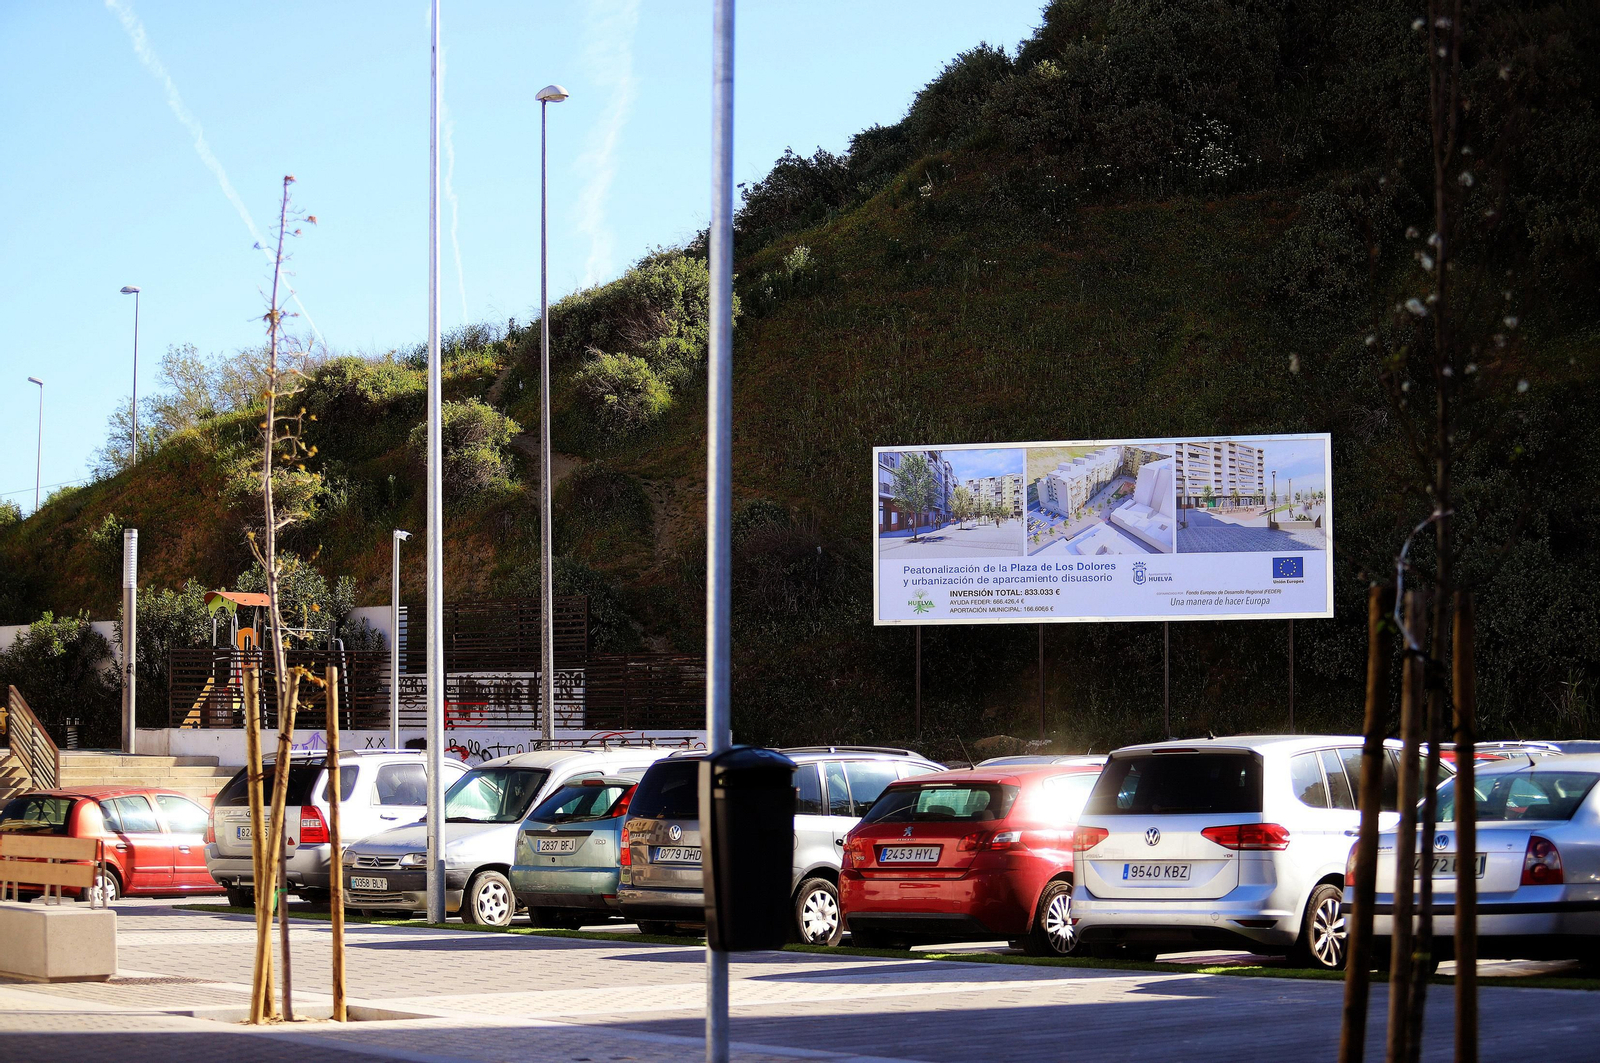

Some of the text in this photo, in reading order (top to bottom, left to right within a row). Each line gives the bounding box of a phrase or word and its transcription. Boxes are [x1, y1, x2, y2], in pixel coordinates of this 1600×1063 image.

[903, 561, 1116, 574] Peatonalización de la Plaza de Los Dolores
[903, 572, 1113, 587] y urbanización de aparcamiento disuasorio
[950, 588, 993, 597] INVERSIÓN
[1024, 588, 1053, 596] 833.033
[1055, 588, 1060, 596] €
[1170, 596, 1270, 606] Una manera de hacer Europa
[949, 606, 987, 614] APORTACIÓN
[541, 838, 575, 851] 2837 BFJ
[683, 849, 702, 861] DHD
[886, 848, 935, 860] 2453 HYL
[1130, 866, 1188, 878] 9540 KBZ
